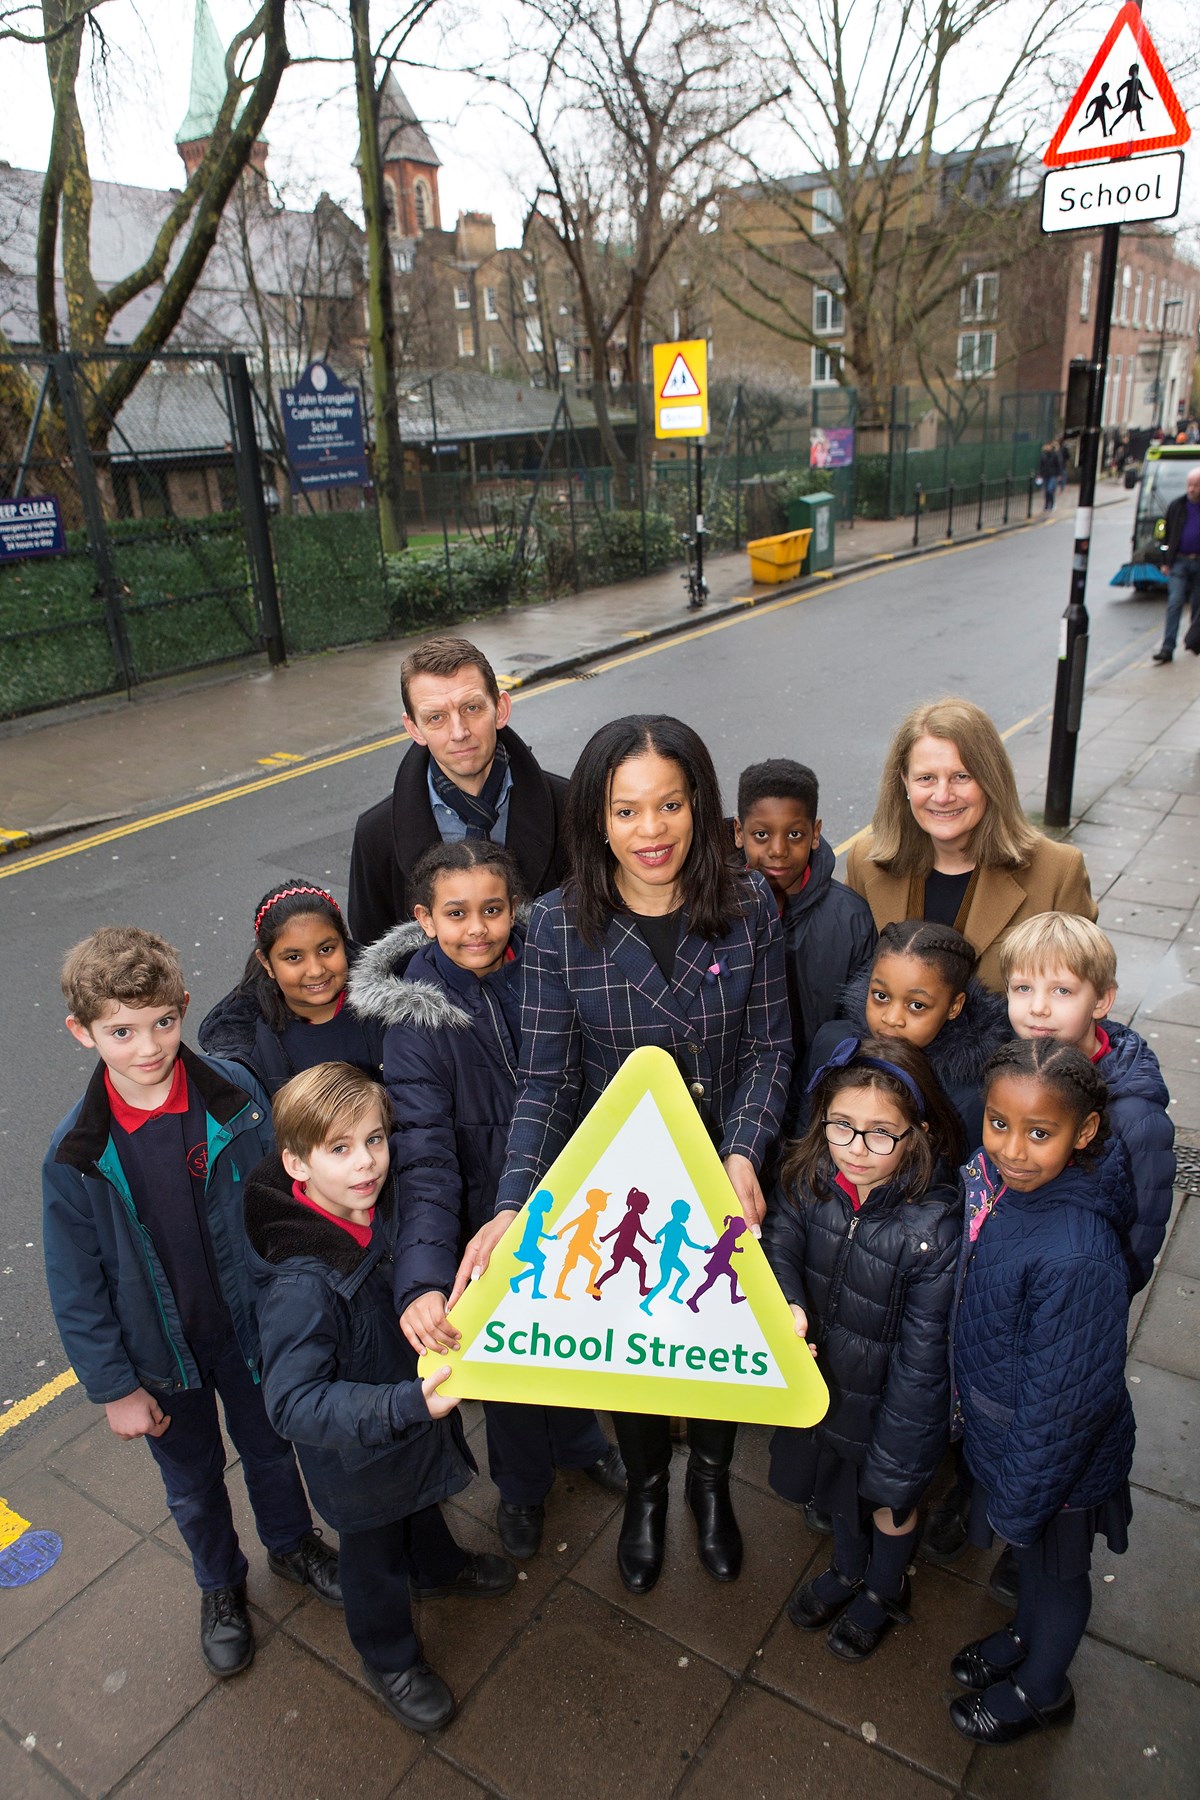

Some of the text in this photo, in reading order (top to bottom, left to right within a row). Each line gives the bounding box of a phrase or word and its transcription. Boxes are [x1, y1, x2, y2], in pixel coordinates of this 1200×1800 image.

[1059, 174, 1161, 212] School
[298, 394, 317, 405] John
[317, 391, 355, 406] Evangelist
[291, 406, 353, 420] Catholic Primary
[311, 420, 338, 433] School
[19, 501, 54, 516] CLEAR
[33, 520, 57, 530] vehicle
[2, 529, 54, 542] access required
[5, 538, 53, 551] 24 hours a day
[483, 1320, 769, 1376] School Streets
